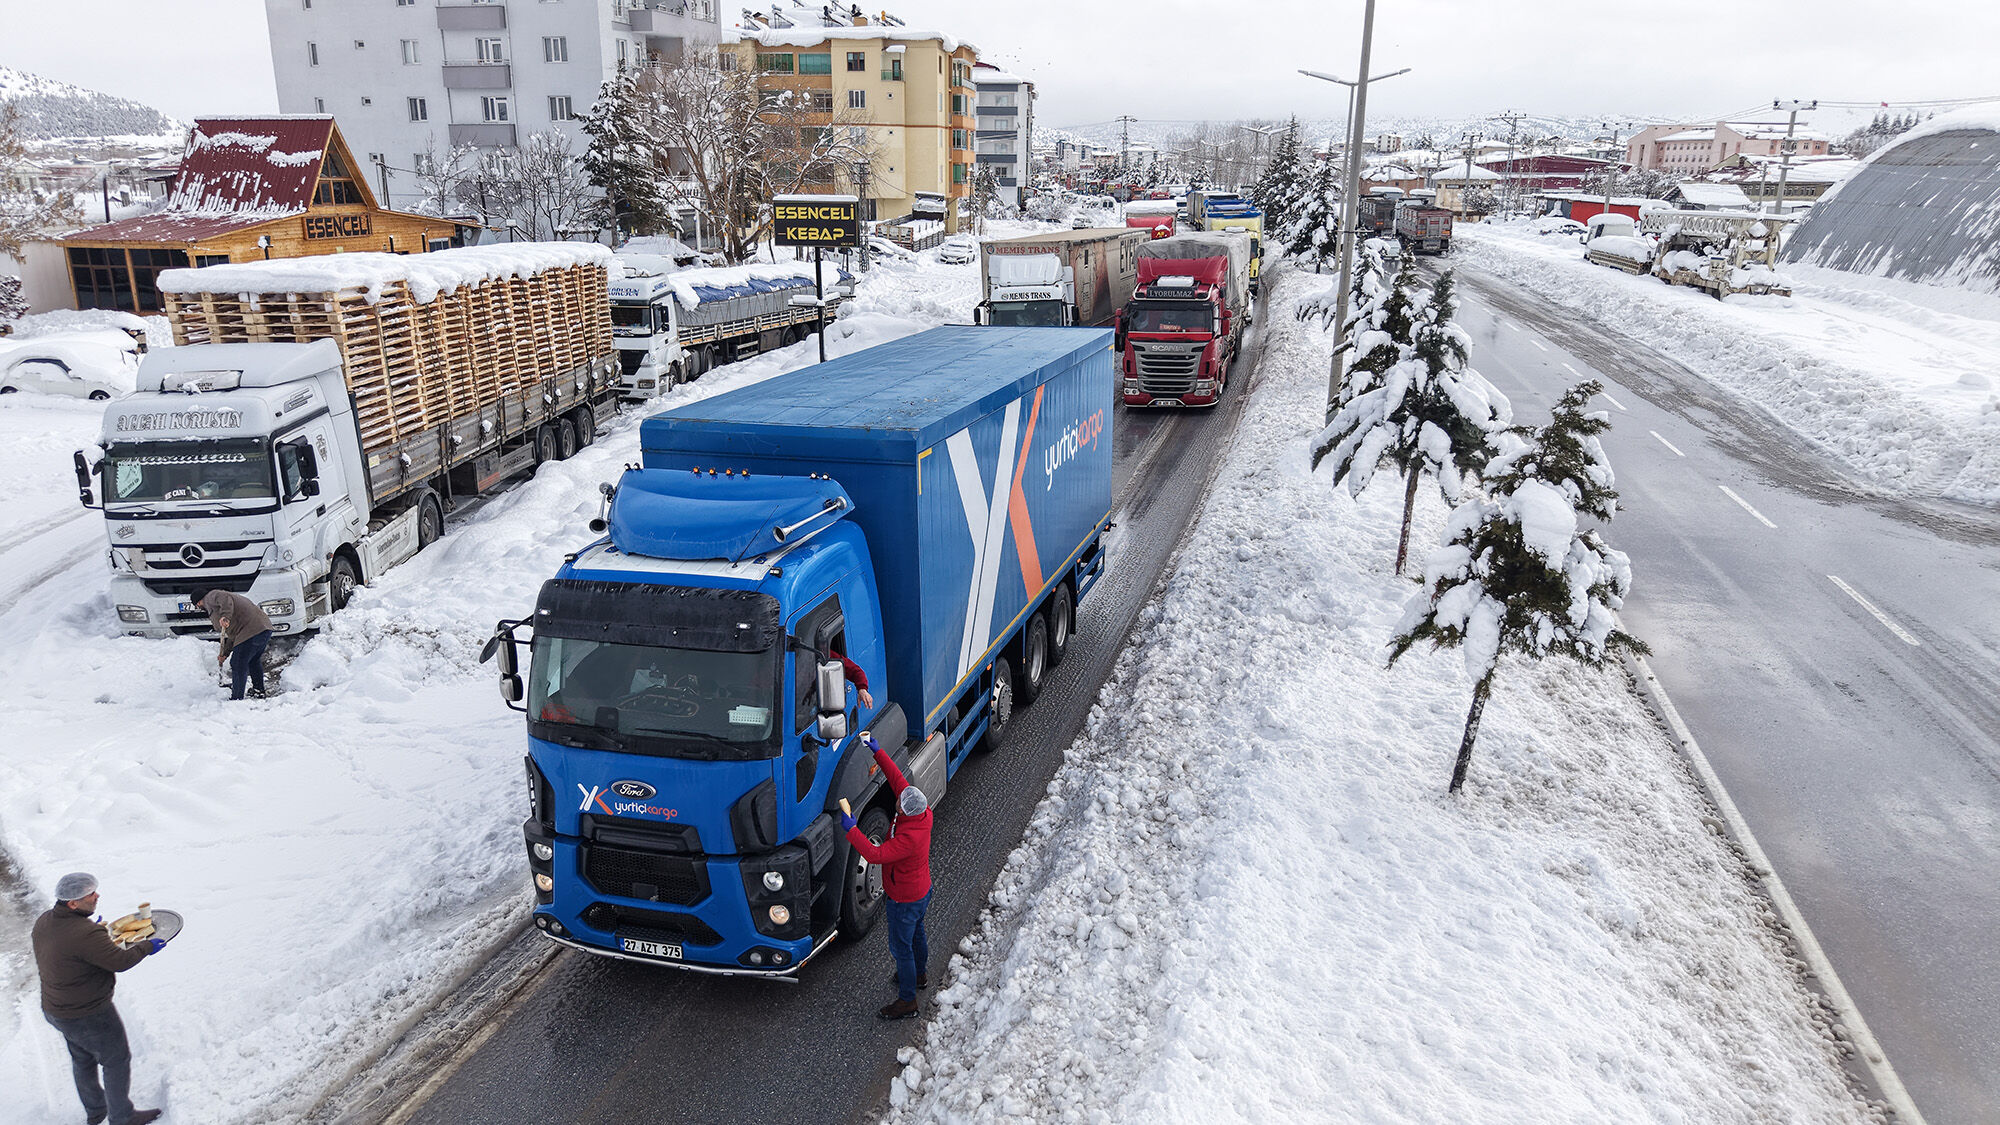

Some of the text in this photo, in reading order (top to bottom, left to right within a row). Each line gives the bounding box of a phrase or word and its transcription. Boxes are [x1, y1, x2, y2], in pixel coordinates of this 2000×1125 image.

[775, 205, 855, 220] ESENCELİ
[786, 227, 845, 241] KEBAP
[1028, 246, 1060, 254] TRANS
[619, 783, 645, 797] Ford
[624, 940, 681, 957] 27 AZT 375
